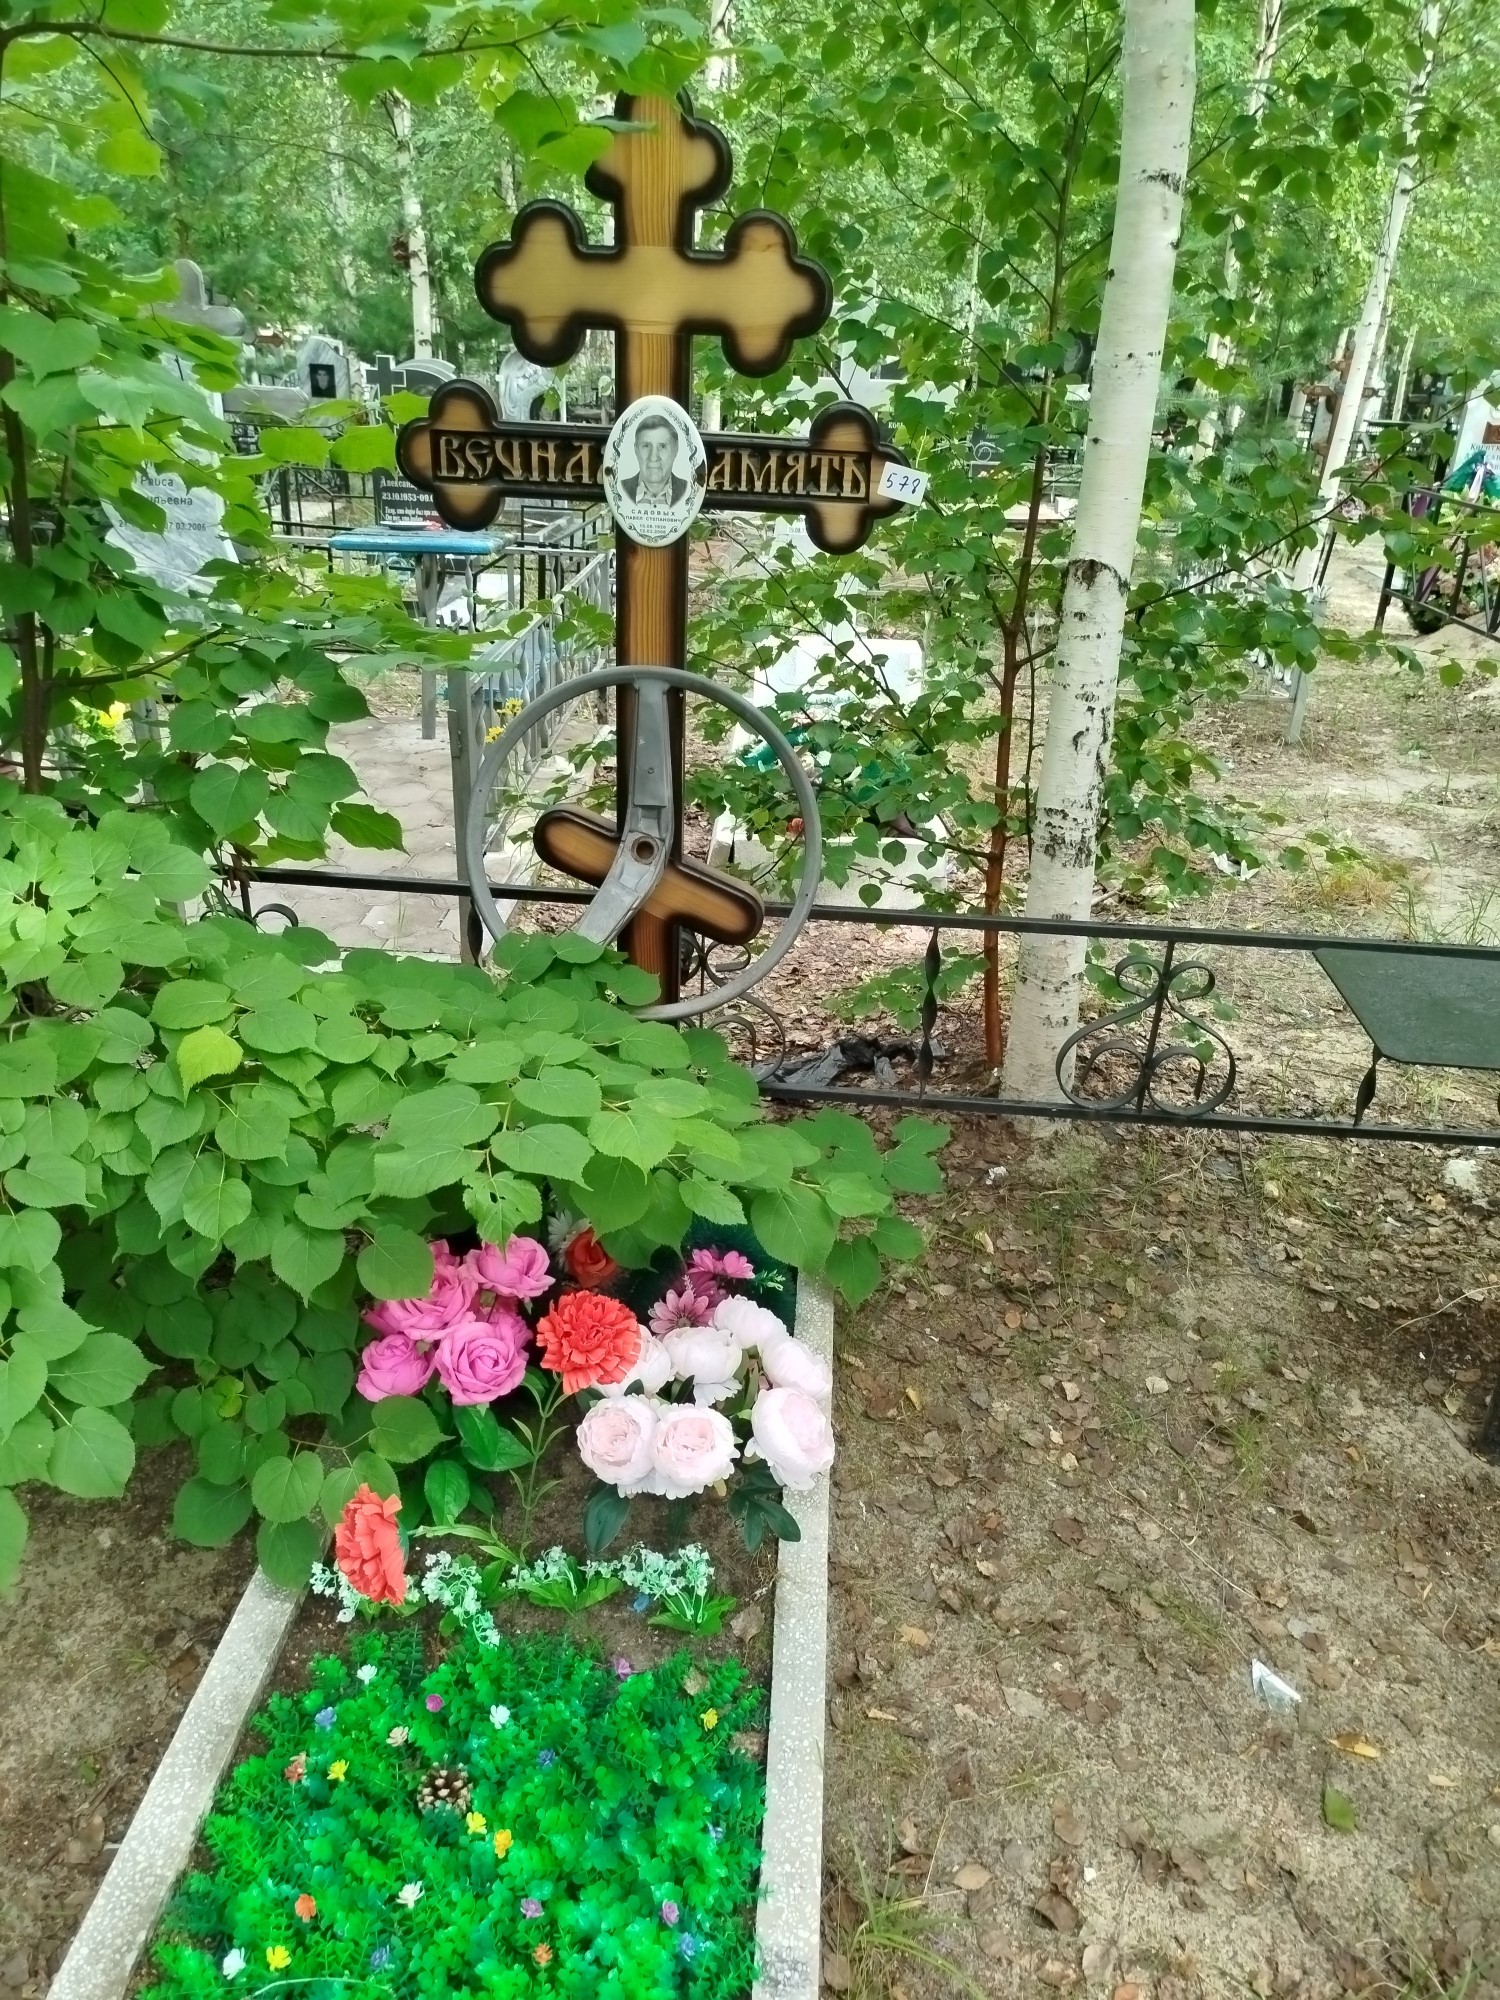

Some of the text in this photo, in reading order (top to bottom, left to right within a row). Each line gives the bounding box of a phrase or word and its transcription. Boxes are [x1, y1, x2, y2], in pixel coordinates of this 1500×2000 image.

[140, 476, 174, 487] Раиса
[706, 447, 867, 499] АМЯТЬ
[886, 472, 921, 495] 578
